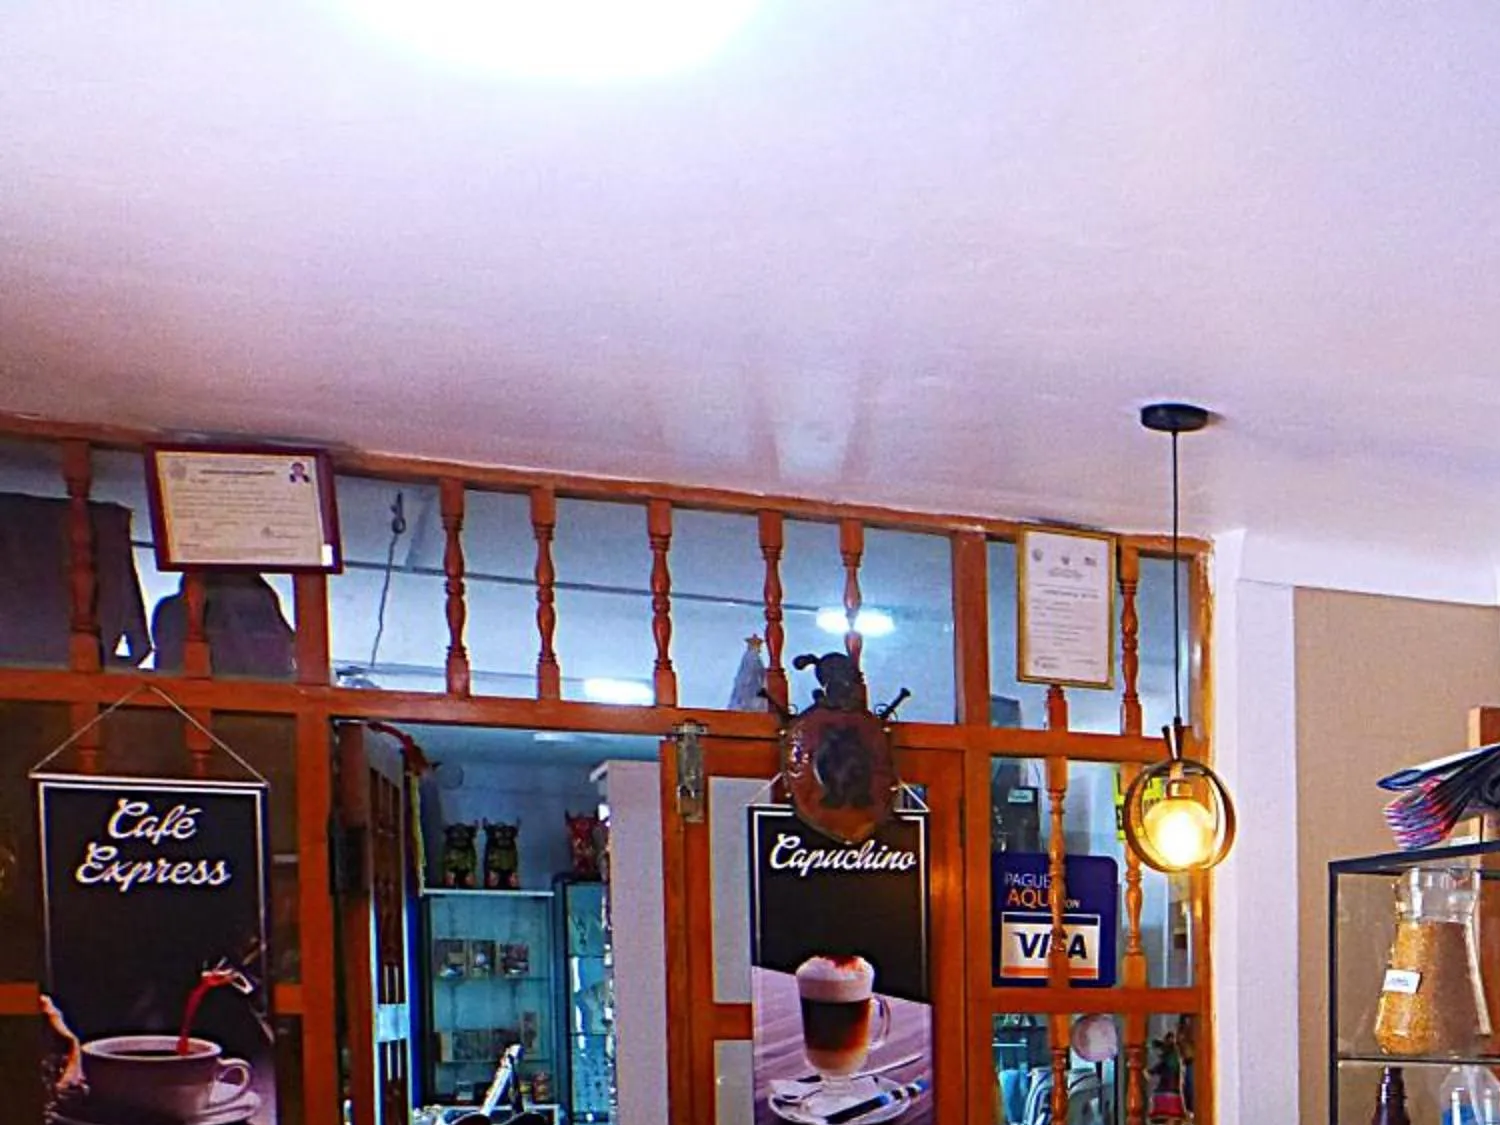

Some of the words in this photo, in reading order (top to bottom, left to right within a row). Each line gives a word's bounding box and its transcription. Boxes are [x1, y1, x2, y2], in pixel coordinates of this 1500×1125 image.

[107, 798, 203, 845] Café
[75, 842, 233, 892] Express
[769, 833, 917, 877] Capuchino
[1012, 930, 1088, 959] VIA
